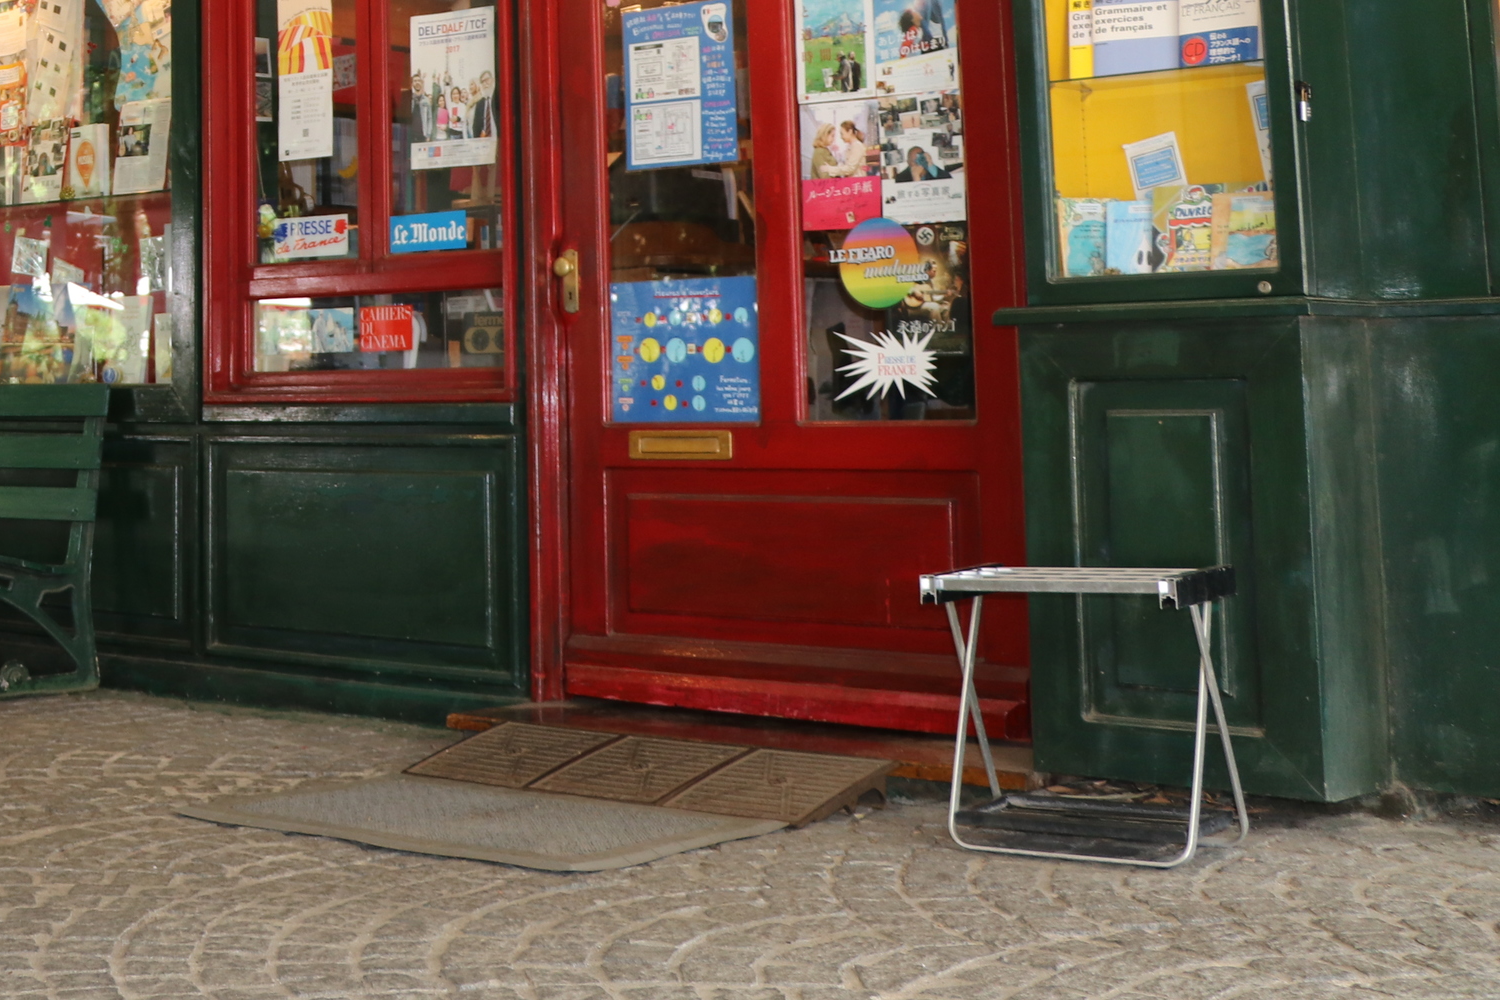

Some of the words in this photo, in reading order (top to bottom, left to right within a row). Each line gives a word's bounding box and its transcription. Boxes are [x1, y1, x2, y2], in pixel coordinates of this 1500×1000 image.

[1094, 5, 1153, 16] Grammaire
[1181, 6, 1191, 17] LE
[1193, 1, 1241, 15] FRANÇAIS
[1094, 15, 1144, 25] exercices
[1072, 31, 1085, 39] de
[1094, 26, 1107, 35] de
[1110, 23, 1153, 33] français
[445, 45, 460, 54] 2017
[1184, 42, 1206, 57] CD
[1210, 38, 1251, 48] フランス語への
[806, 180, 873, 203] ルージュの手紙
[290, 219, 332, 236] PRESSE
[392, 223, 409, 246] Le
[409, 220, 465, 244] Monde
[276, 243, 291, 254] de
[293, 236, 346, 251] France
[829, 249, 847, 264] LE
[848, 245, 895, 263] FIGARO
[863, 259, 928, 279] madame
[896, 273, 929, 283] FIGARO
[360, 305, 412, 321] CAHIERS
[360, 322, 375, 336] DU
[360, 335, 407, 349] CINEMA
[878, 364, 917, 376] FRANCE
